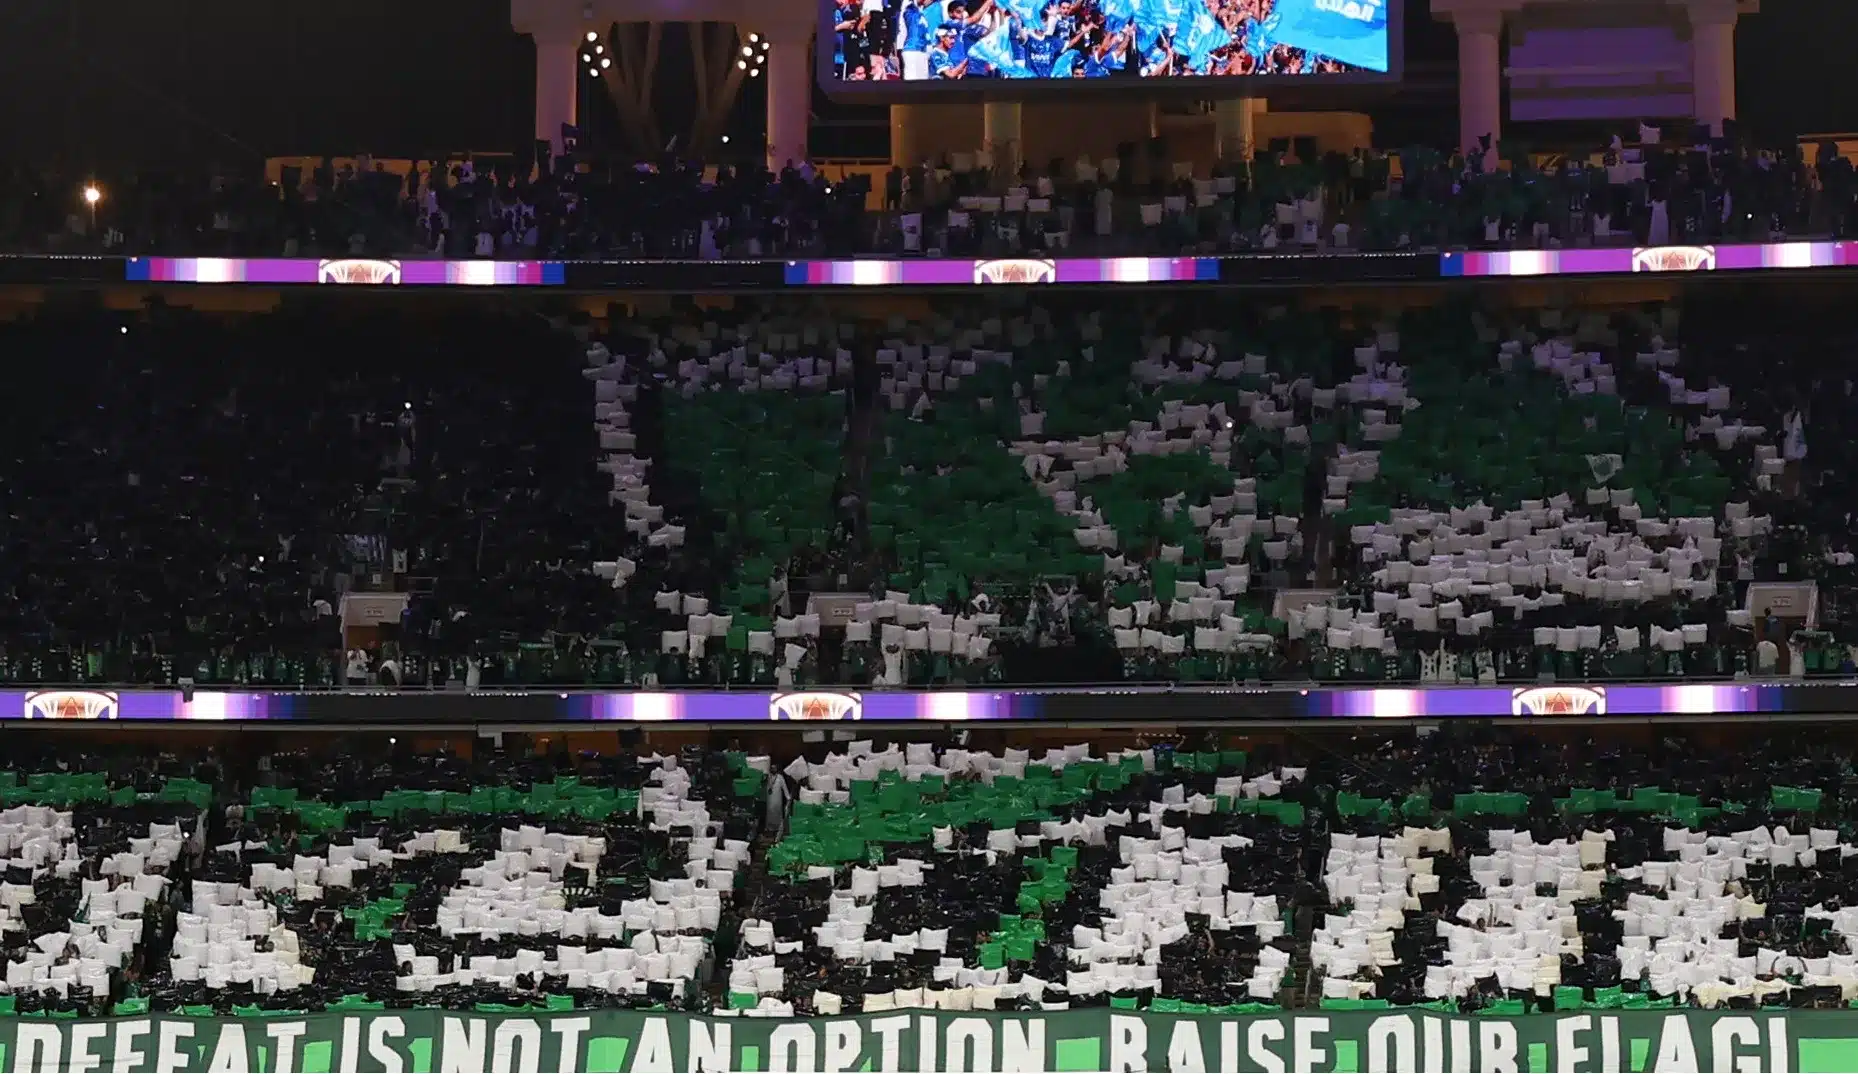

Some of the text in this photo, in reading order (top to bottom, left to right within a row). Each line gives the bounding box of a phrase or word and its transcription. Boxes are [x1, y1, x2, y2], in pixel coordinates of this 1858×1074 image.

[13, 1019, 306, 1073] DEFEAT
[339, 1016, 405, 1073] IS
[440, 1016, 591, 1073] NOT
[630, 1017, 732, 1073] AN
[769, 1015, 1046, 1073] OPTION
[1110, 1015, 1330, 1073] RAISE
[1368, 1014, 1518, 1073] OUR
